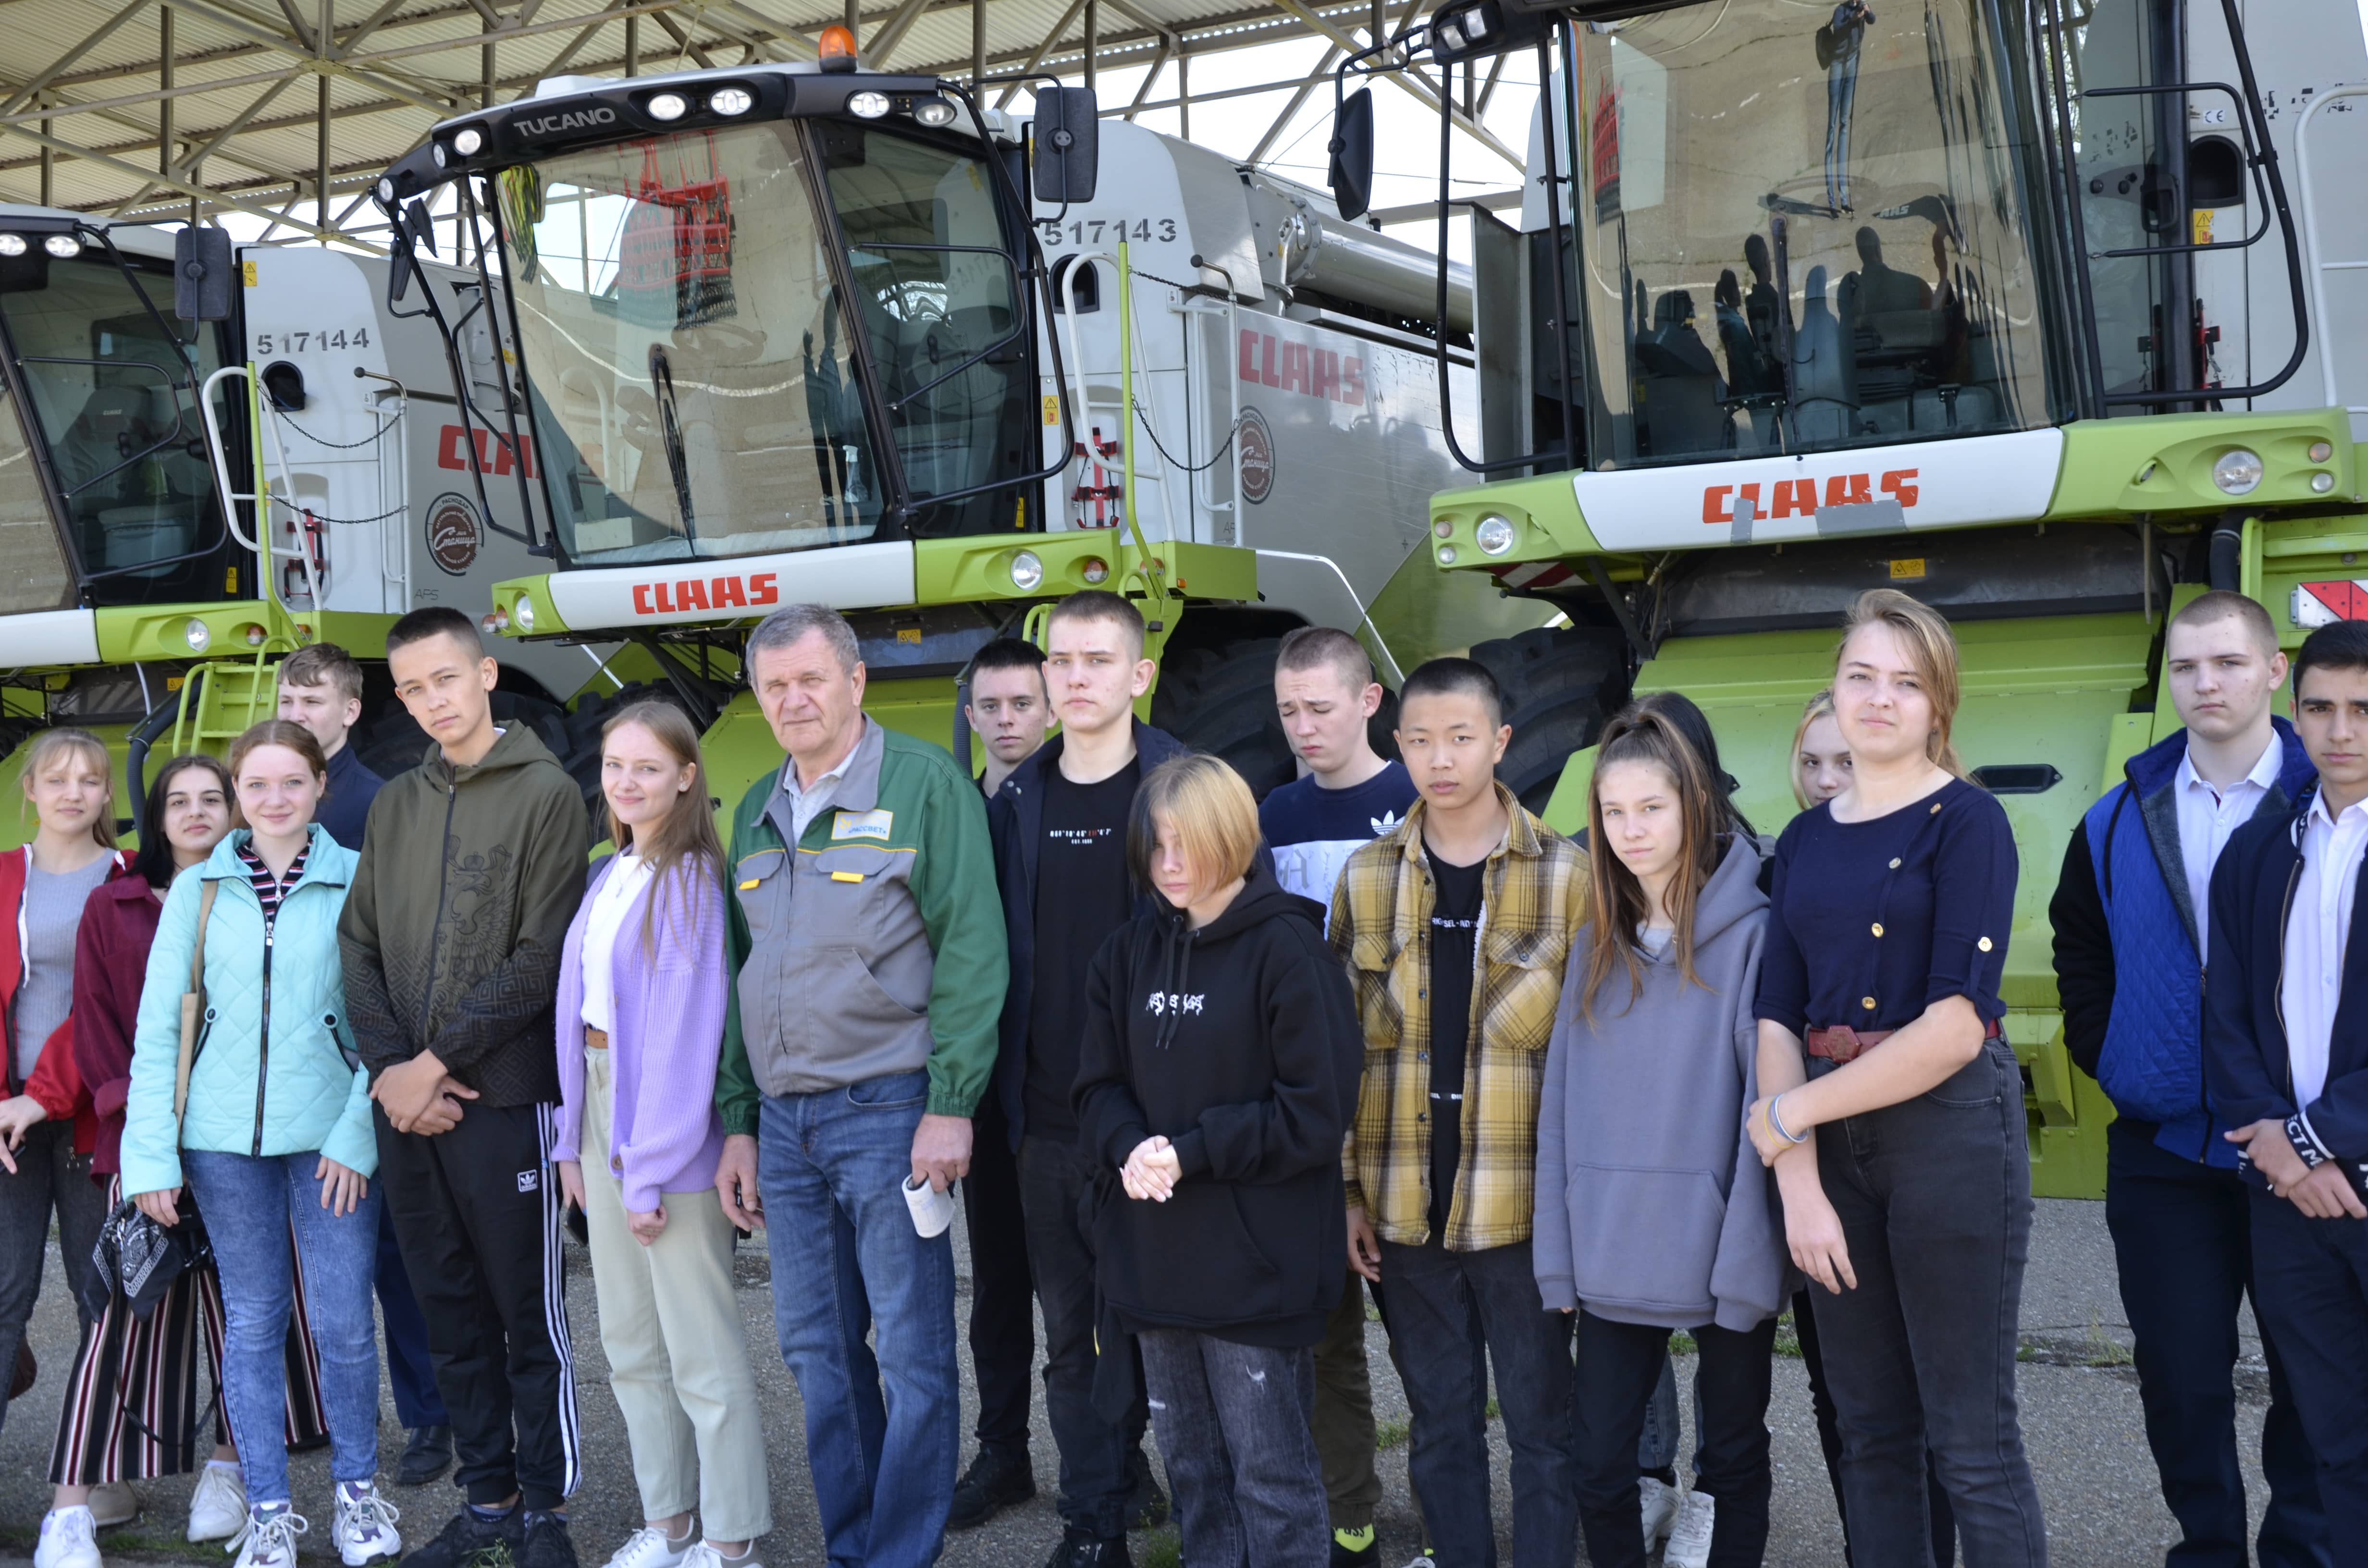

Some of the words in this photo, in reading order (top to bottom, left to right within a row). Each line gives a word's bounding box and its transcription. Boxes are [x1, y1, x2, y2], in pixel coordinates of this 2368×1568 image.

[514, 108, 616, 137] TUCANO
[1044, 219, 1177, 245] 517143
[258, 328, 370, 355] 517144
[1239, 329, 1364, 405] CLAAS
[438, 425, 539, 479] CLA
[437, 497, 469, 509] РАСНОДАР
[1702, 468, 1919, 524] CLAAS
[414, 588, 439, 600] APS
[633, 573, 778, 615] CLAAS
